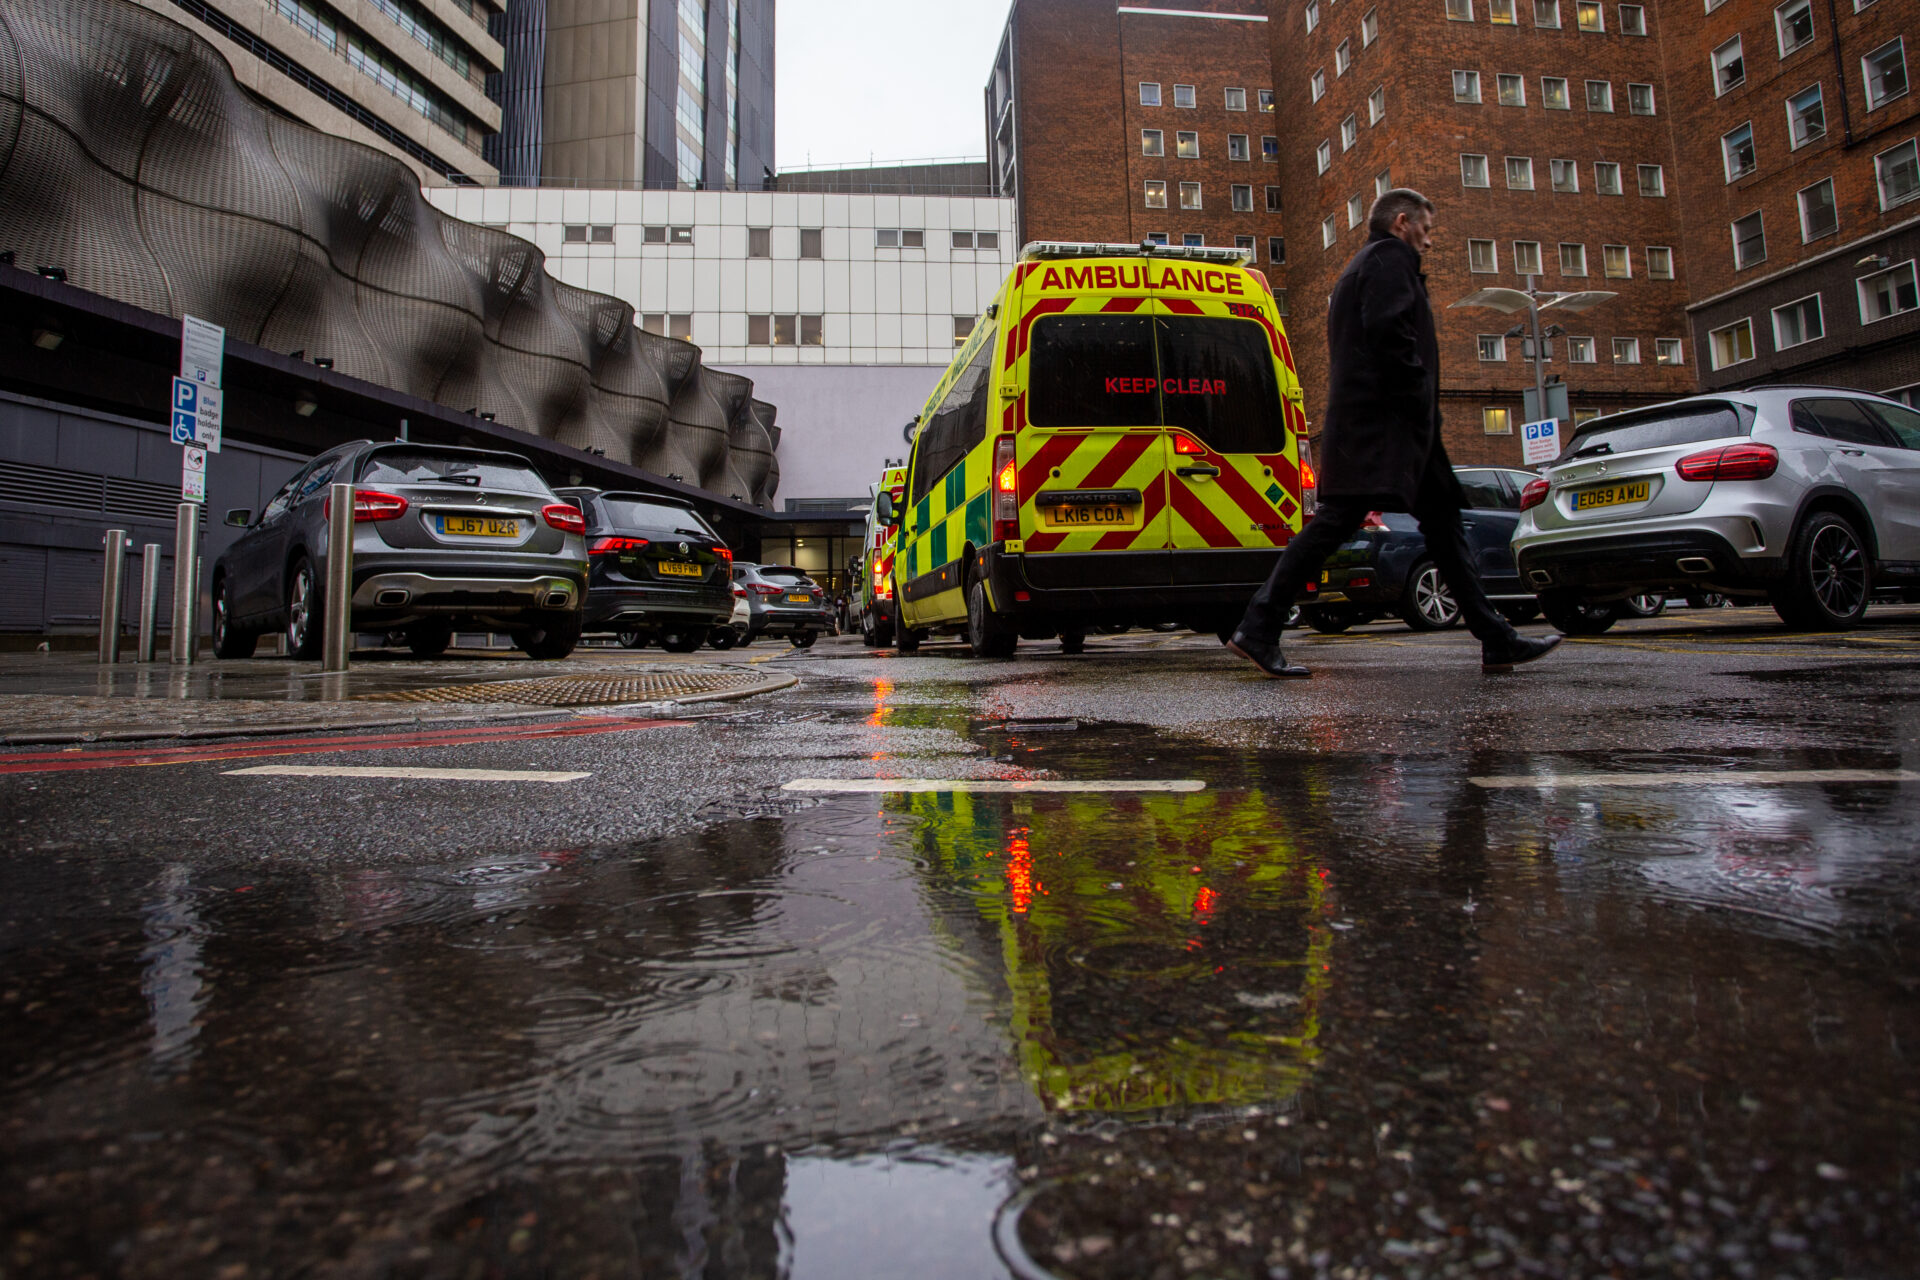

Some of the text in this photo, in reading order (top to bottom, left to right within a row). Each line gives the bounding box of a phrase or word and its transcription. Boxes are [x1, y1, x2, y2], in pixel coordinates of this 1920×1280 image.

[1040, 265, 1245, 296] AMBULANCE
[1229, 303, 1264, 318] B120
[1105, 377, 1226, 395] KEEP CLEAR
[202, 396, 217, 407] Blue
[199, 407, 219, 419] badge
[197, 417, 221, 431] holders
[201, 431, 216, 443] only
[1063, 493, 1117, 502] MASTER
[1617, 483, 1645, 500] AWU
[1054, 508, 1090, 523] LK16
[446, 519, 484, 532] LJ67
[662, 564, 699, 575] LV69 FNR
